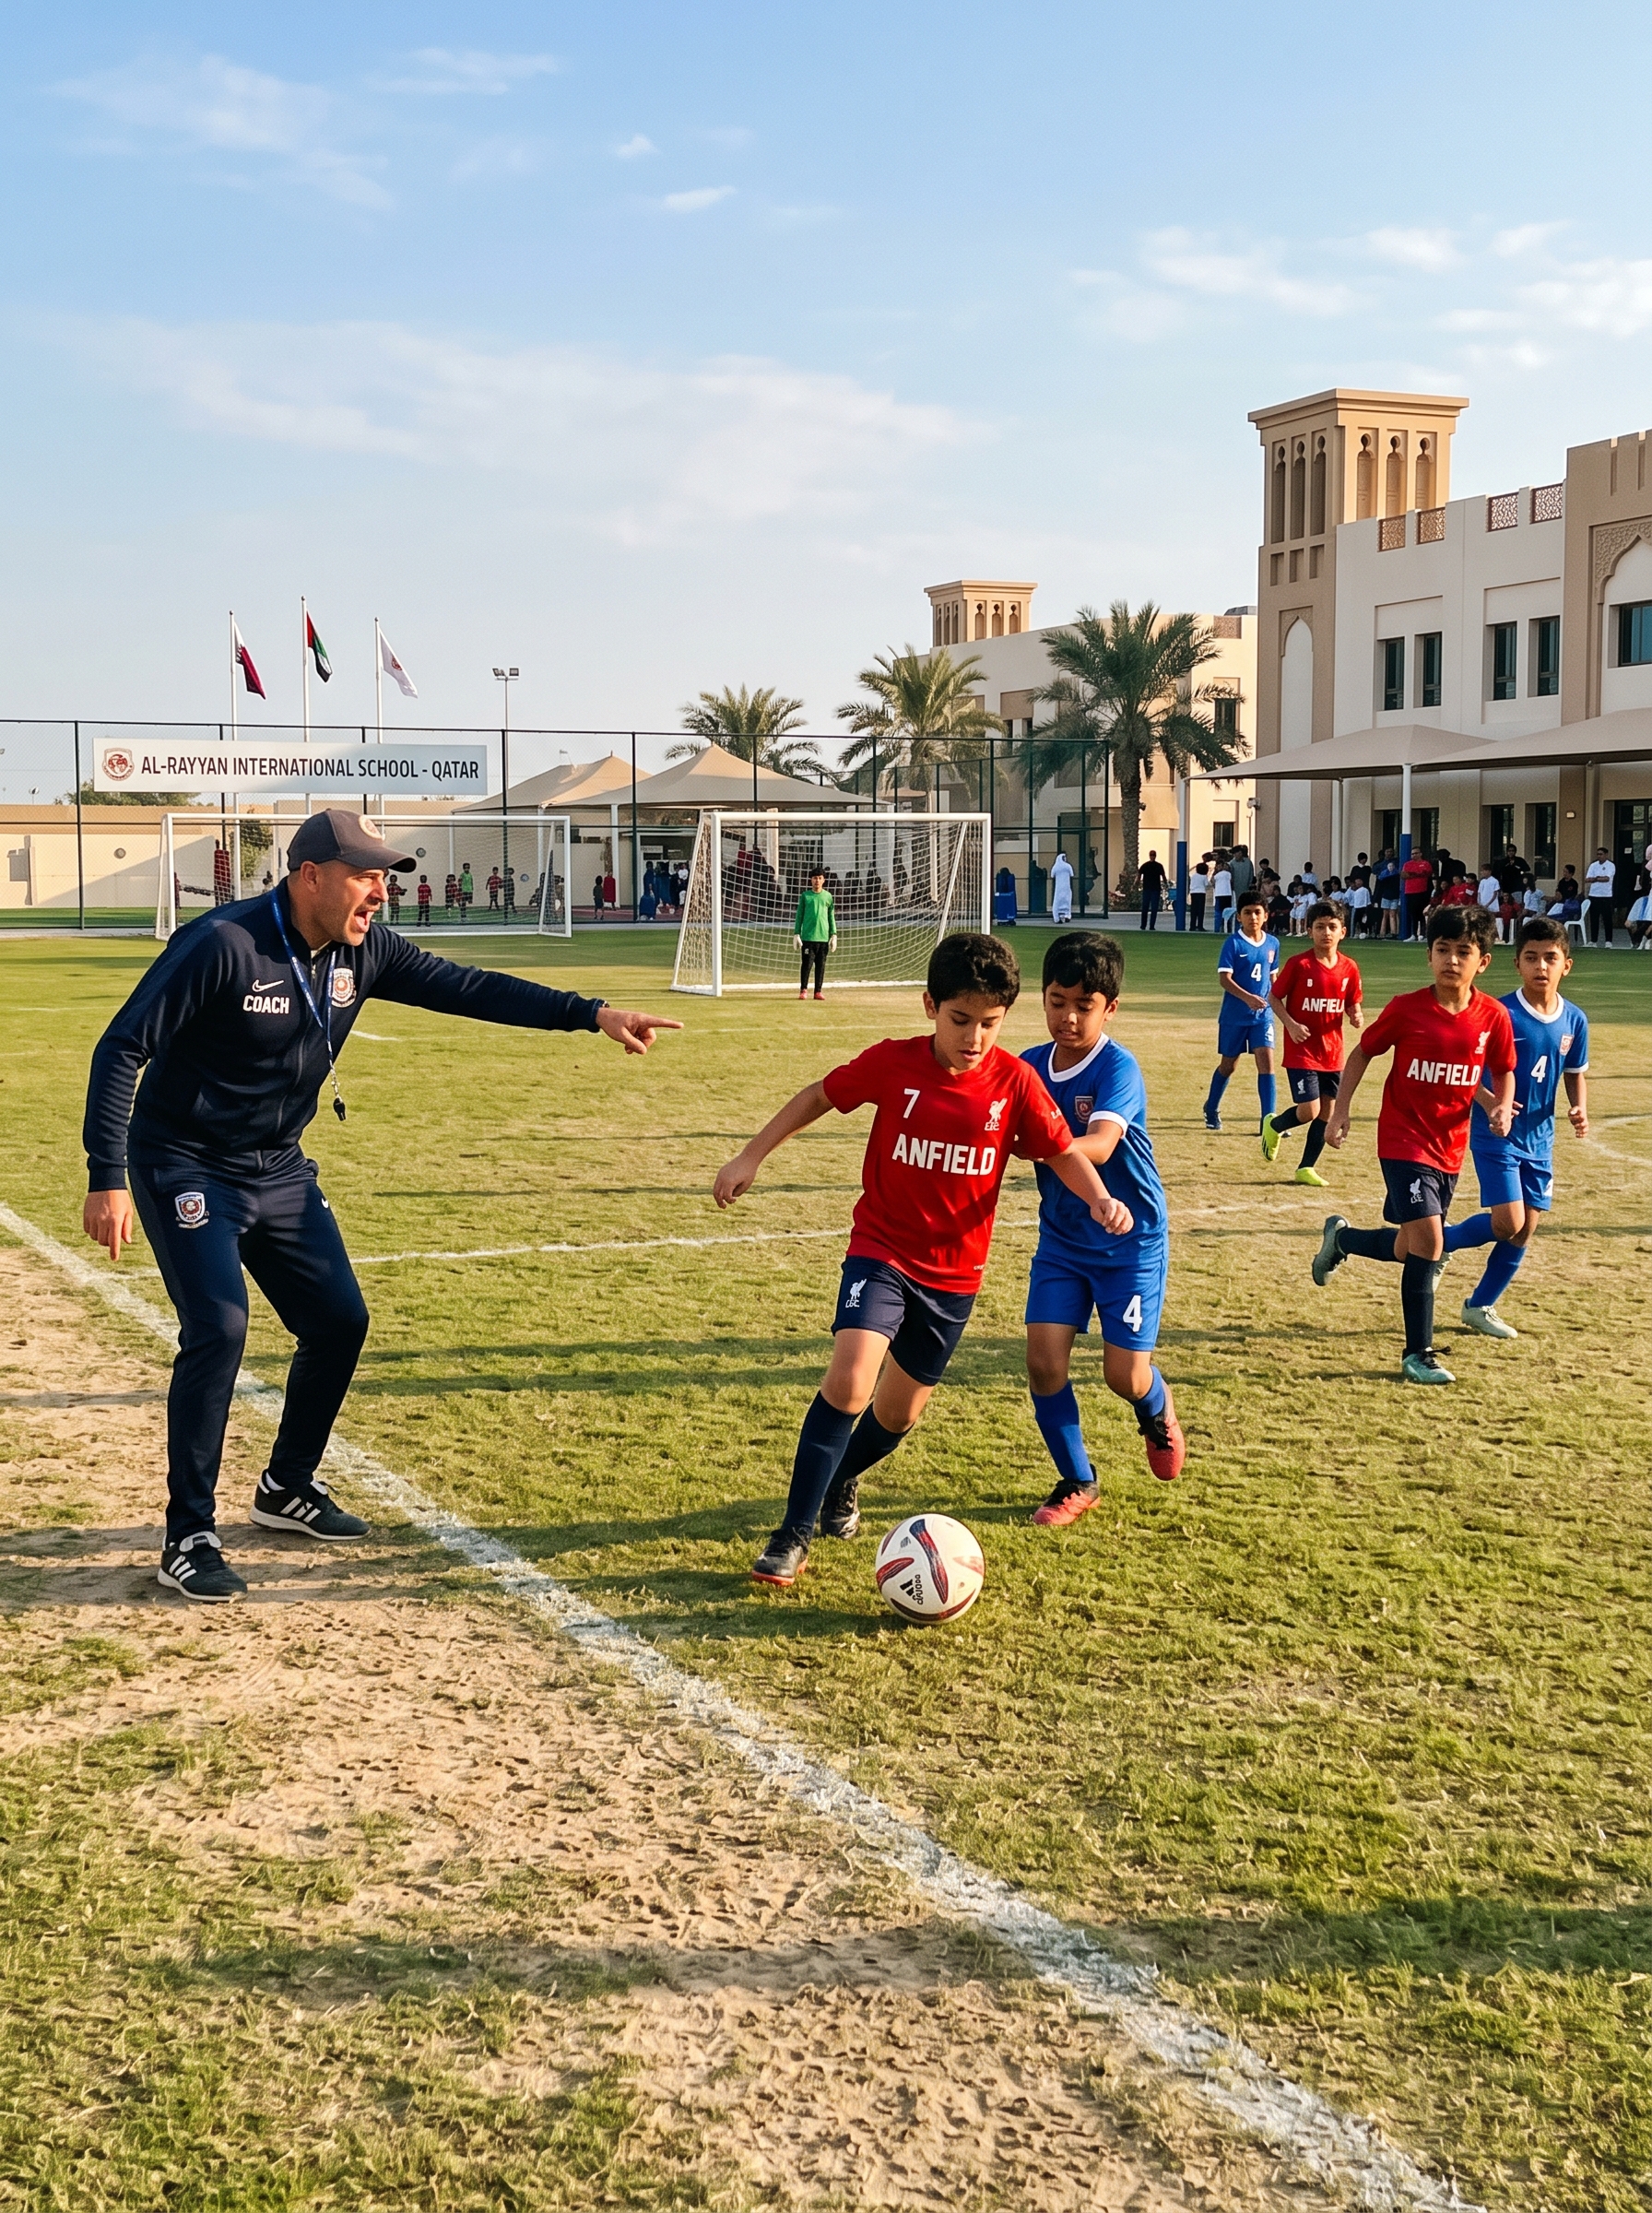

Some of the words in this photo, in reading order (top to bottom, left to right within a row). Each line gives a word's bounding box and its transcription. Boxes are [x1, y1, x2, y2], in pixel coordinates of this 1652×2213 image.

[141, 756, 228, 775] AL-RAYYAN
[233, 757, 354, 776] INTERNATIONAL
[358, 759, 419, 778] SCHOOL
[431, 761, 478, 782] QATAR
[1251, 963, 1262, 982] 4
[242, 994, 290, 1014] COACH
[1406, 1058, 1481, 1086] ANFIELD
[1530, 1055, 1548, 1083] 4
[903, 1087, 921, 1119] 7
[891, 1132, 997, 1176] ANFIELD
[1122, 1295, 1143, 1332] 4
